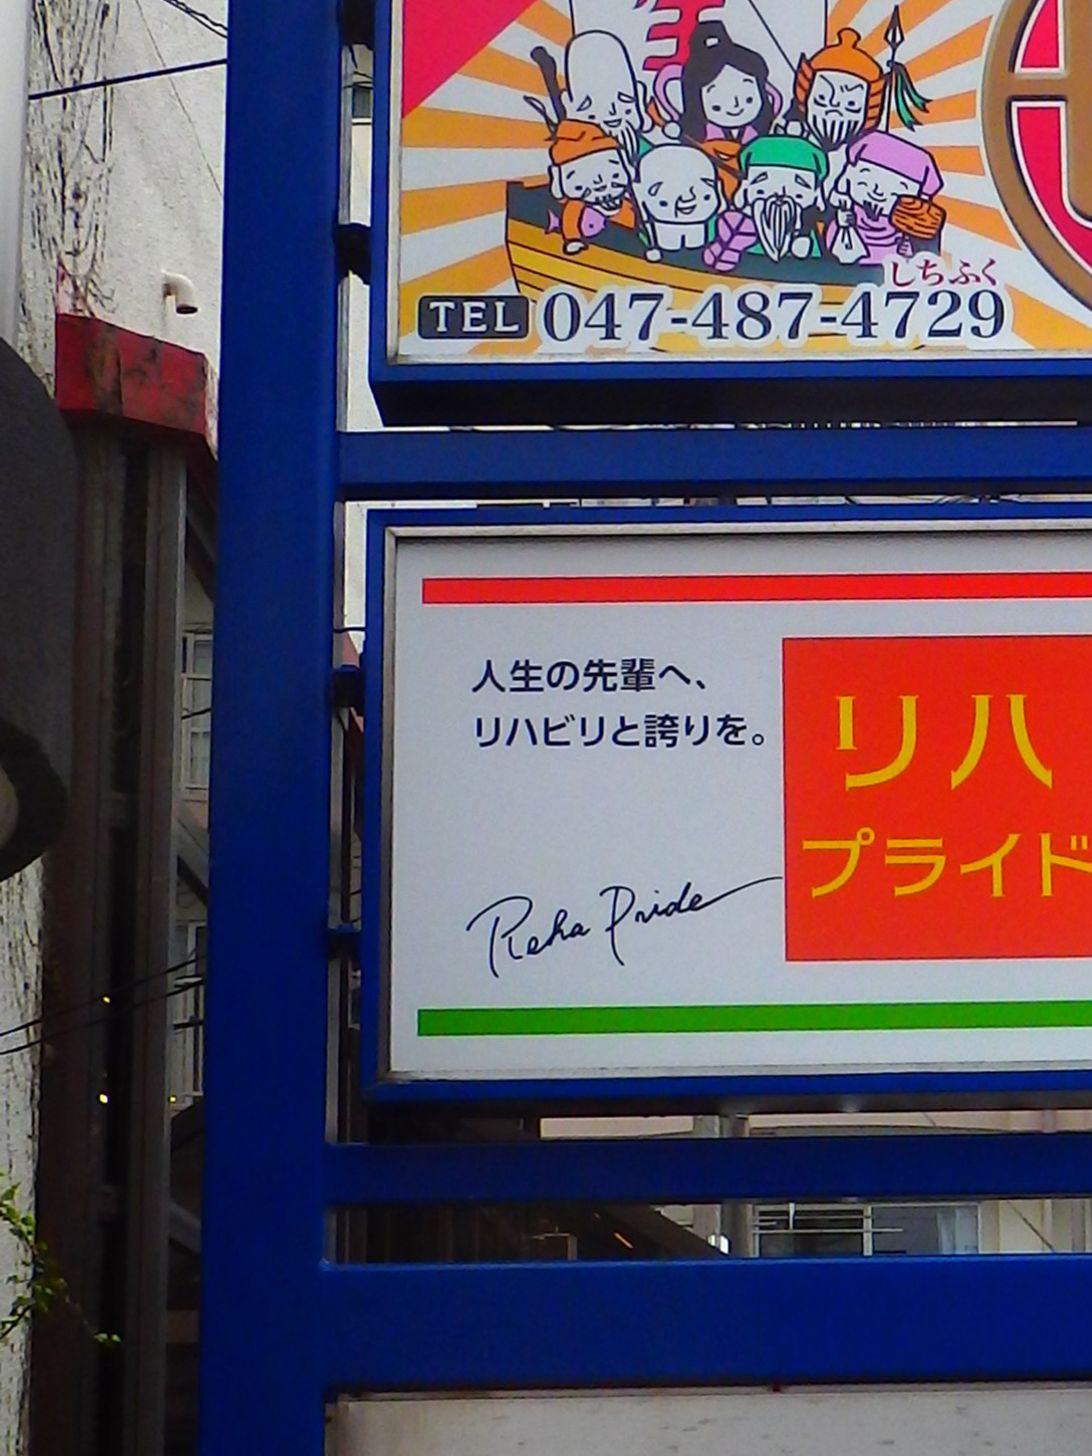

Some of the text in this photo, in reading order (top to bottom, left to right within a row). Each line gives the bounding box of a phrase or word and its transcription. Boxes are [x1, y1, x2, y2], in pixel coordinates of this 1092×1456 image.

[889, 258, 1001, 289] しちふく
[427, 290, 1006, 343] TEL 047-487-4729
[471, 658, 706, 694] 人生の先輩へ、
[474, 714, 767, 749] リハビリと誇りを。
[835, 693, 1054, 793] リハ
[466, 876, 784, 979] Reha Pride
